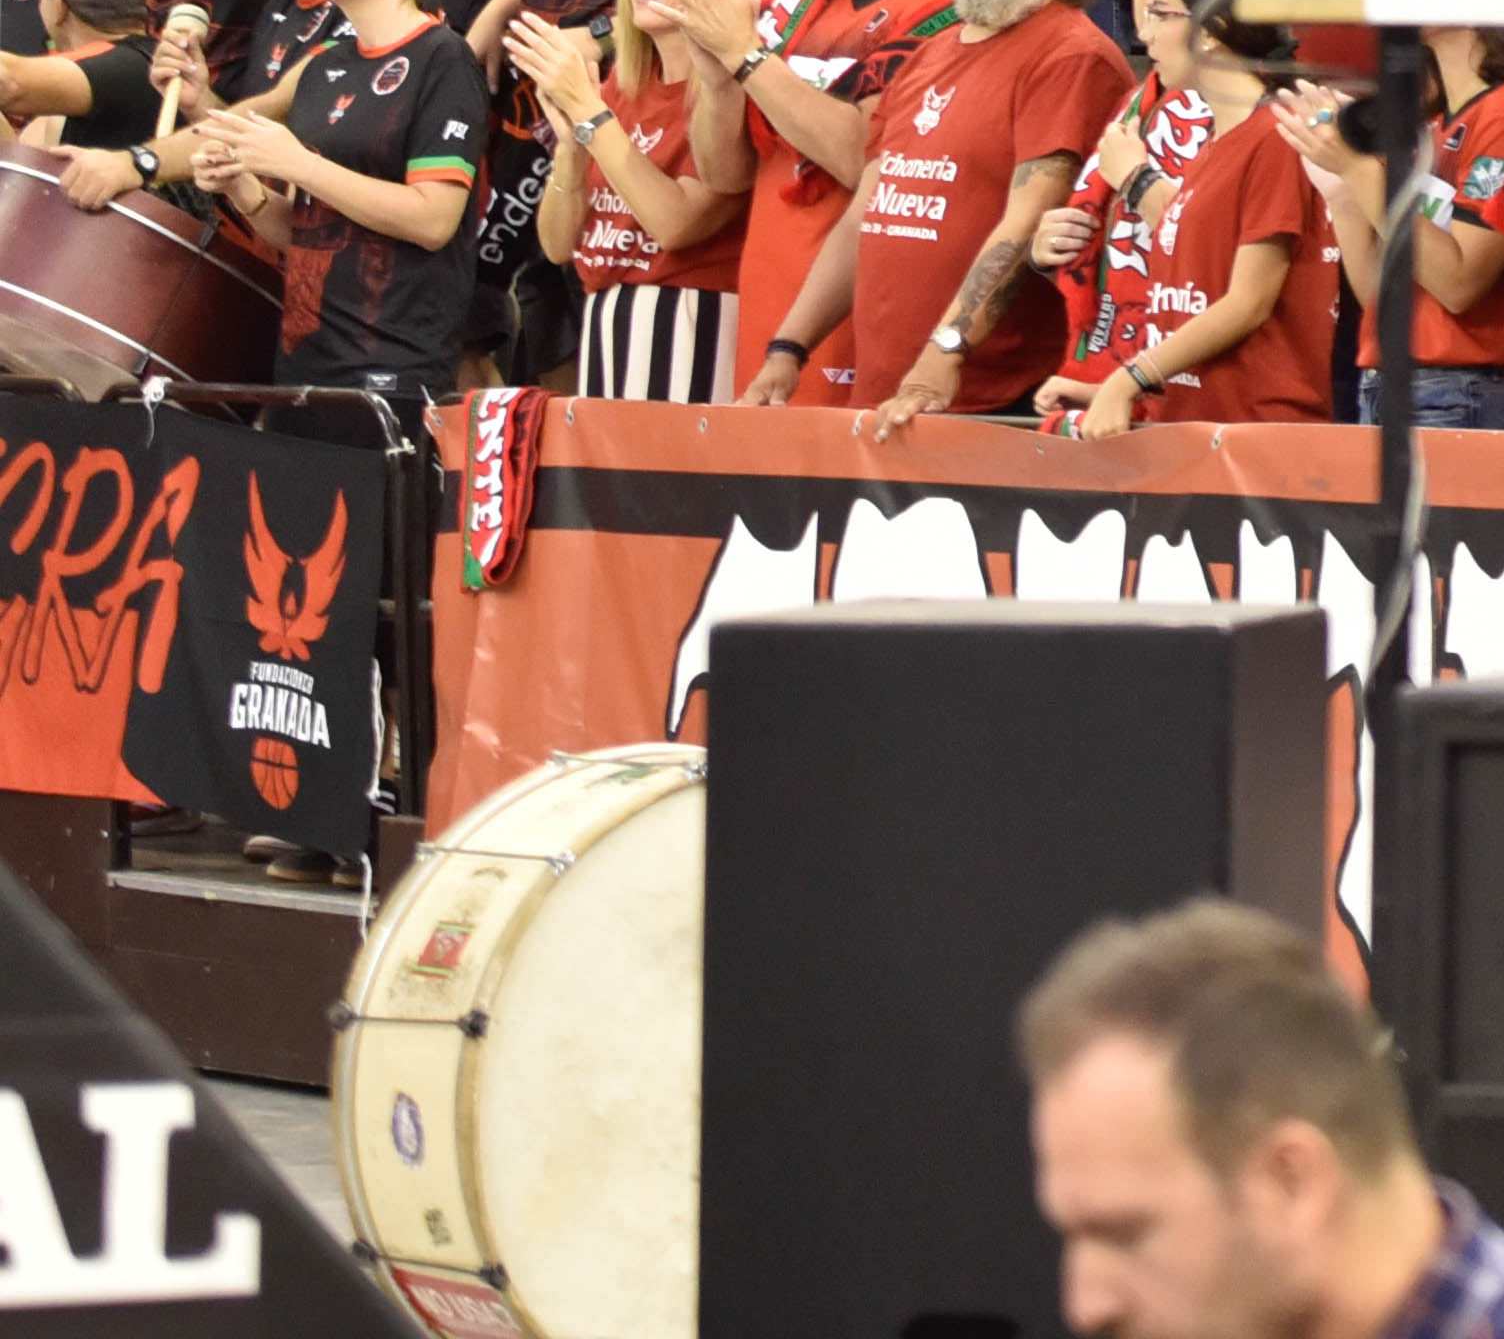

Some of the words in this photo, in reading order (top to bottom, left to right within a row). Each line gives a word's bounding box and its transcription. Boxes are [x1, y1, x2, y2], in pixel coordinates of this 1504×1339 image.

[480, 157, 556, 264] endes
[874, 182, 947, 222] Nueva
[230, 683, 332, 750] GRANADA
